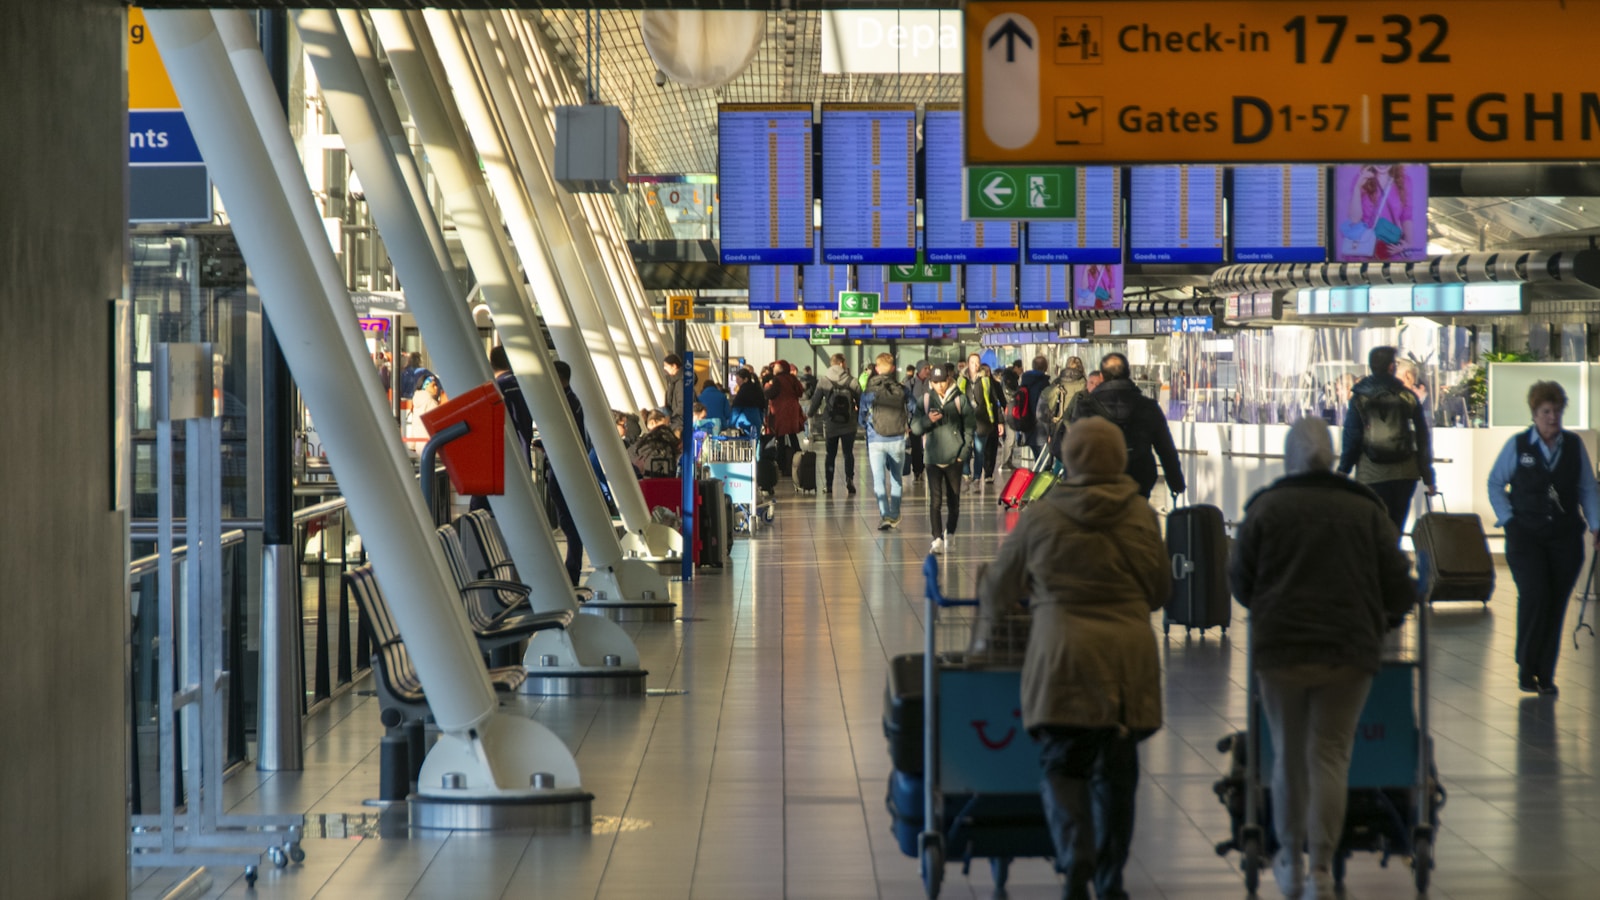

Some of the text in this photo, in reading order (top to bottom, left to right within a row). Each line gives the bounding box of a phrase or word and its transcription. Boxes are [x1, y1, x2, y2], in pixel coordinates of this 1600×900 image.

[857, 17, 958, 57] Depa
[1118, 14, 1451, 64] Check-in 17-32
[1118, 105, 1219, 133] Gates
[130, 129, 169, 148] nts
